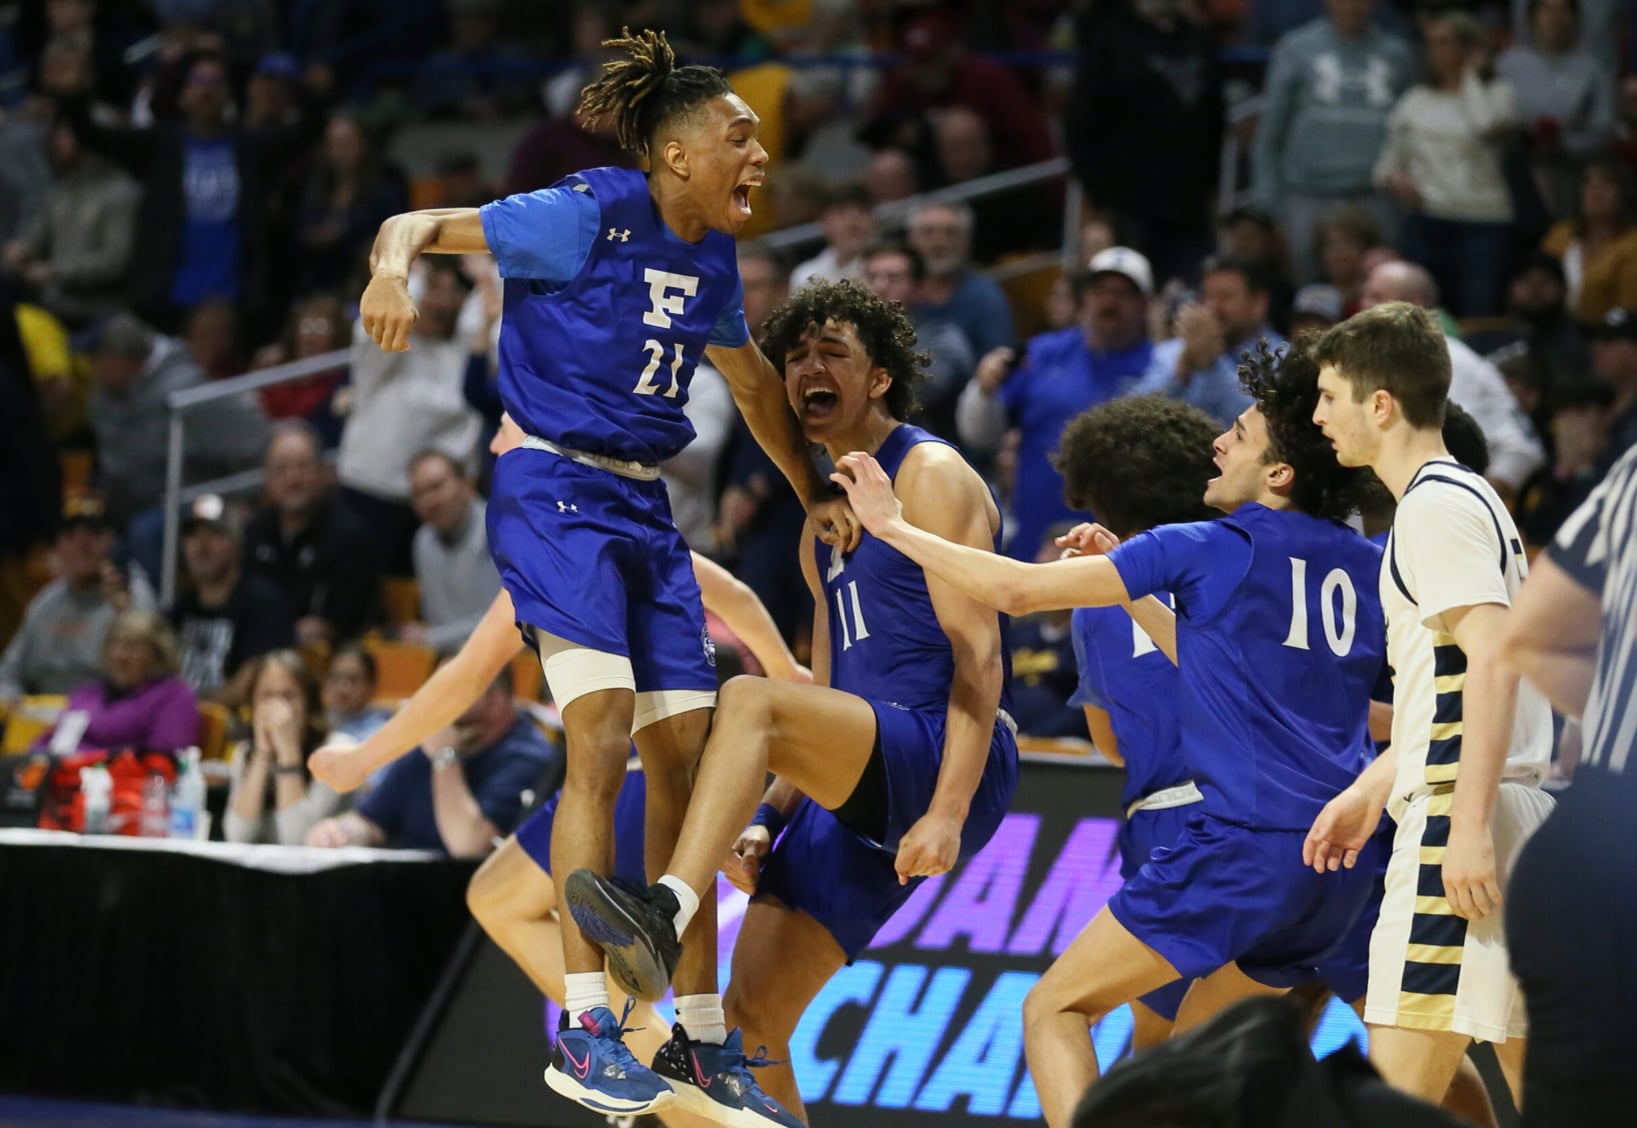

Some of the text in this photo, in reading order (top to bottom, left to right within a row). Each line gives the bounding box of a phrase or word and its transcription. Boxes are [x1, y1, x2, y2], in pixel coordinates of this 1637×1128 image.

[643, 268, 699, 328] F
[633, 339, 684, 398] 21
[836, 580, 870, 651] 11
[1281, 556, 1357, 657] 10
